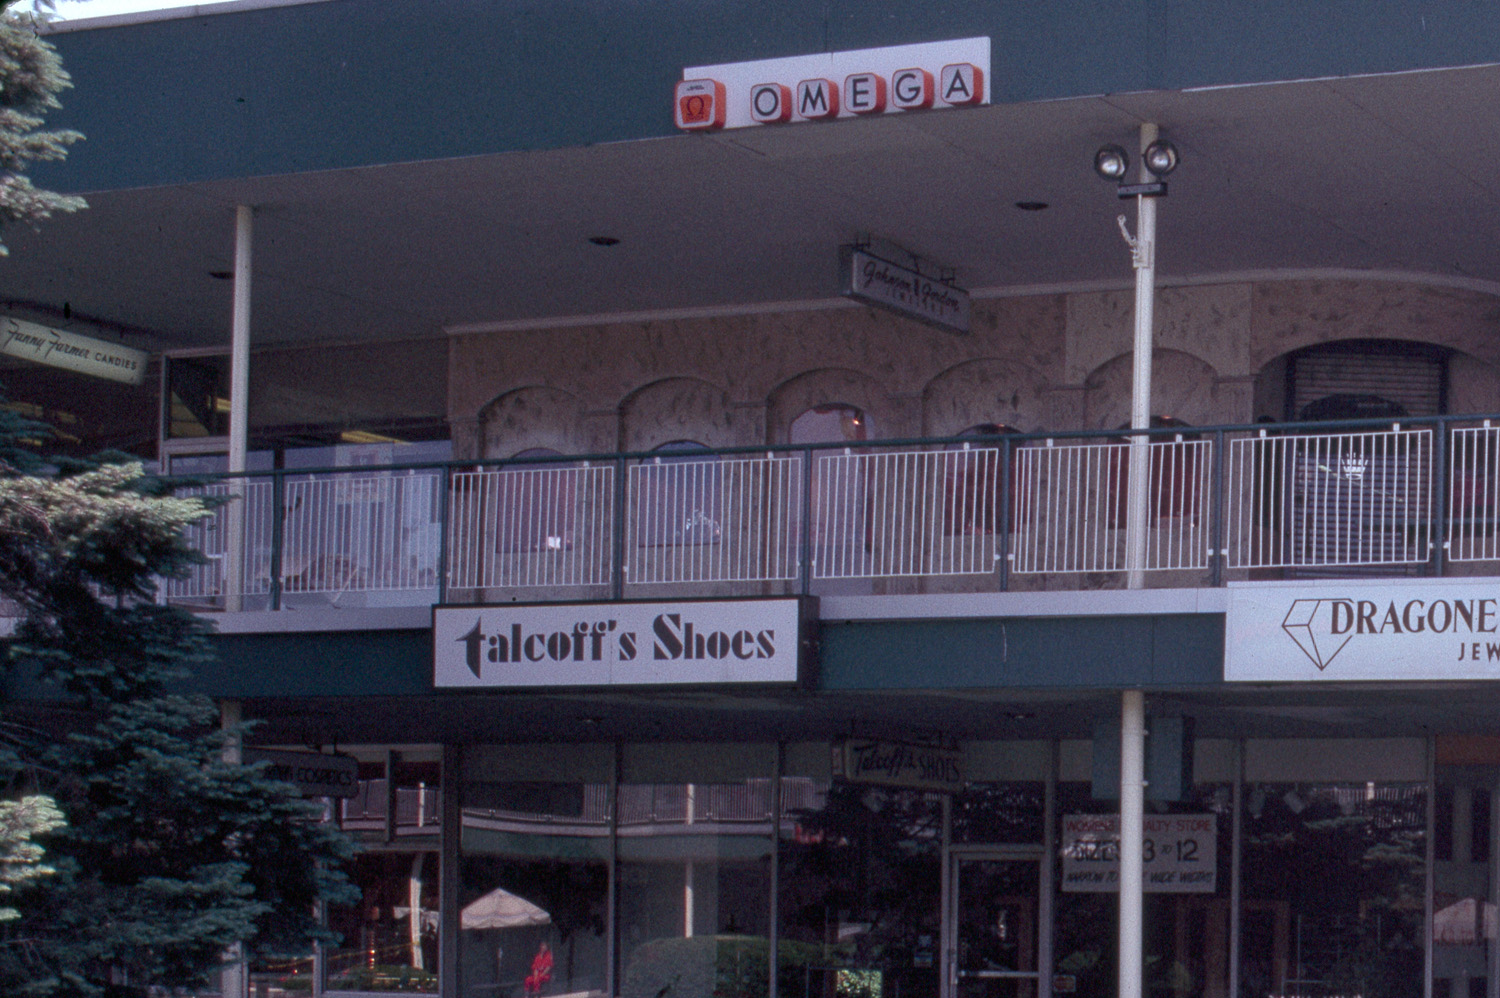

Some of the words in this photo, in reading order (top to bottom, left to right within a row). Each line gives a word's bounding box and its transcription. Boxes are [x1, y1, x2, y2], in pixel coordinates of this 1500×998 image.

[754, 69, 970, 117] OMEGA
[3, 320, 46, 353] Fanny
[45, 329, 90, 360] Farmer
[95, 352, 137, 370] CANDIES
[1331, 599, 1497, 635] DRAGONE
[653, 613, 776, 661] Shoes
[918, 754, 960, 782] SHOES
[1176, 819, 1211, 832] STORE
[1176, 838, 1199, 862] 12
